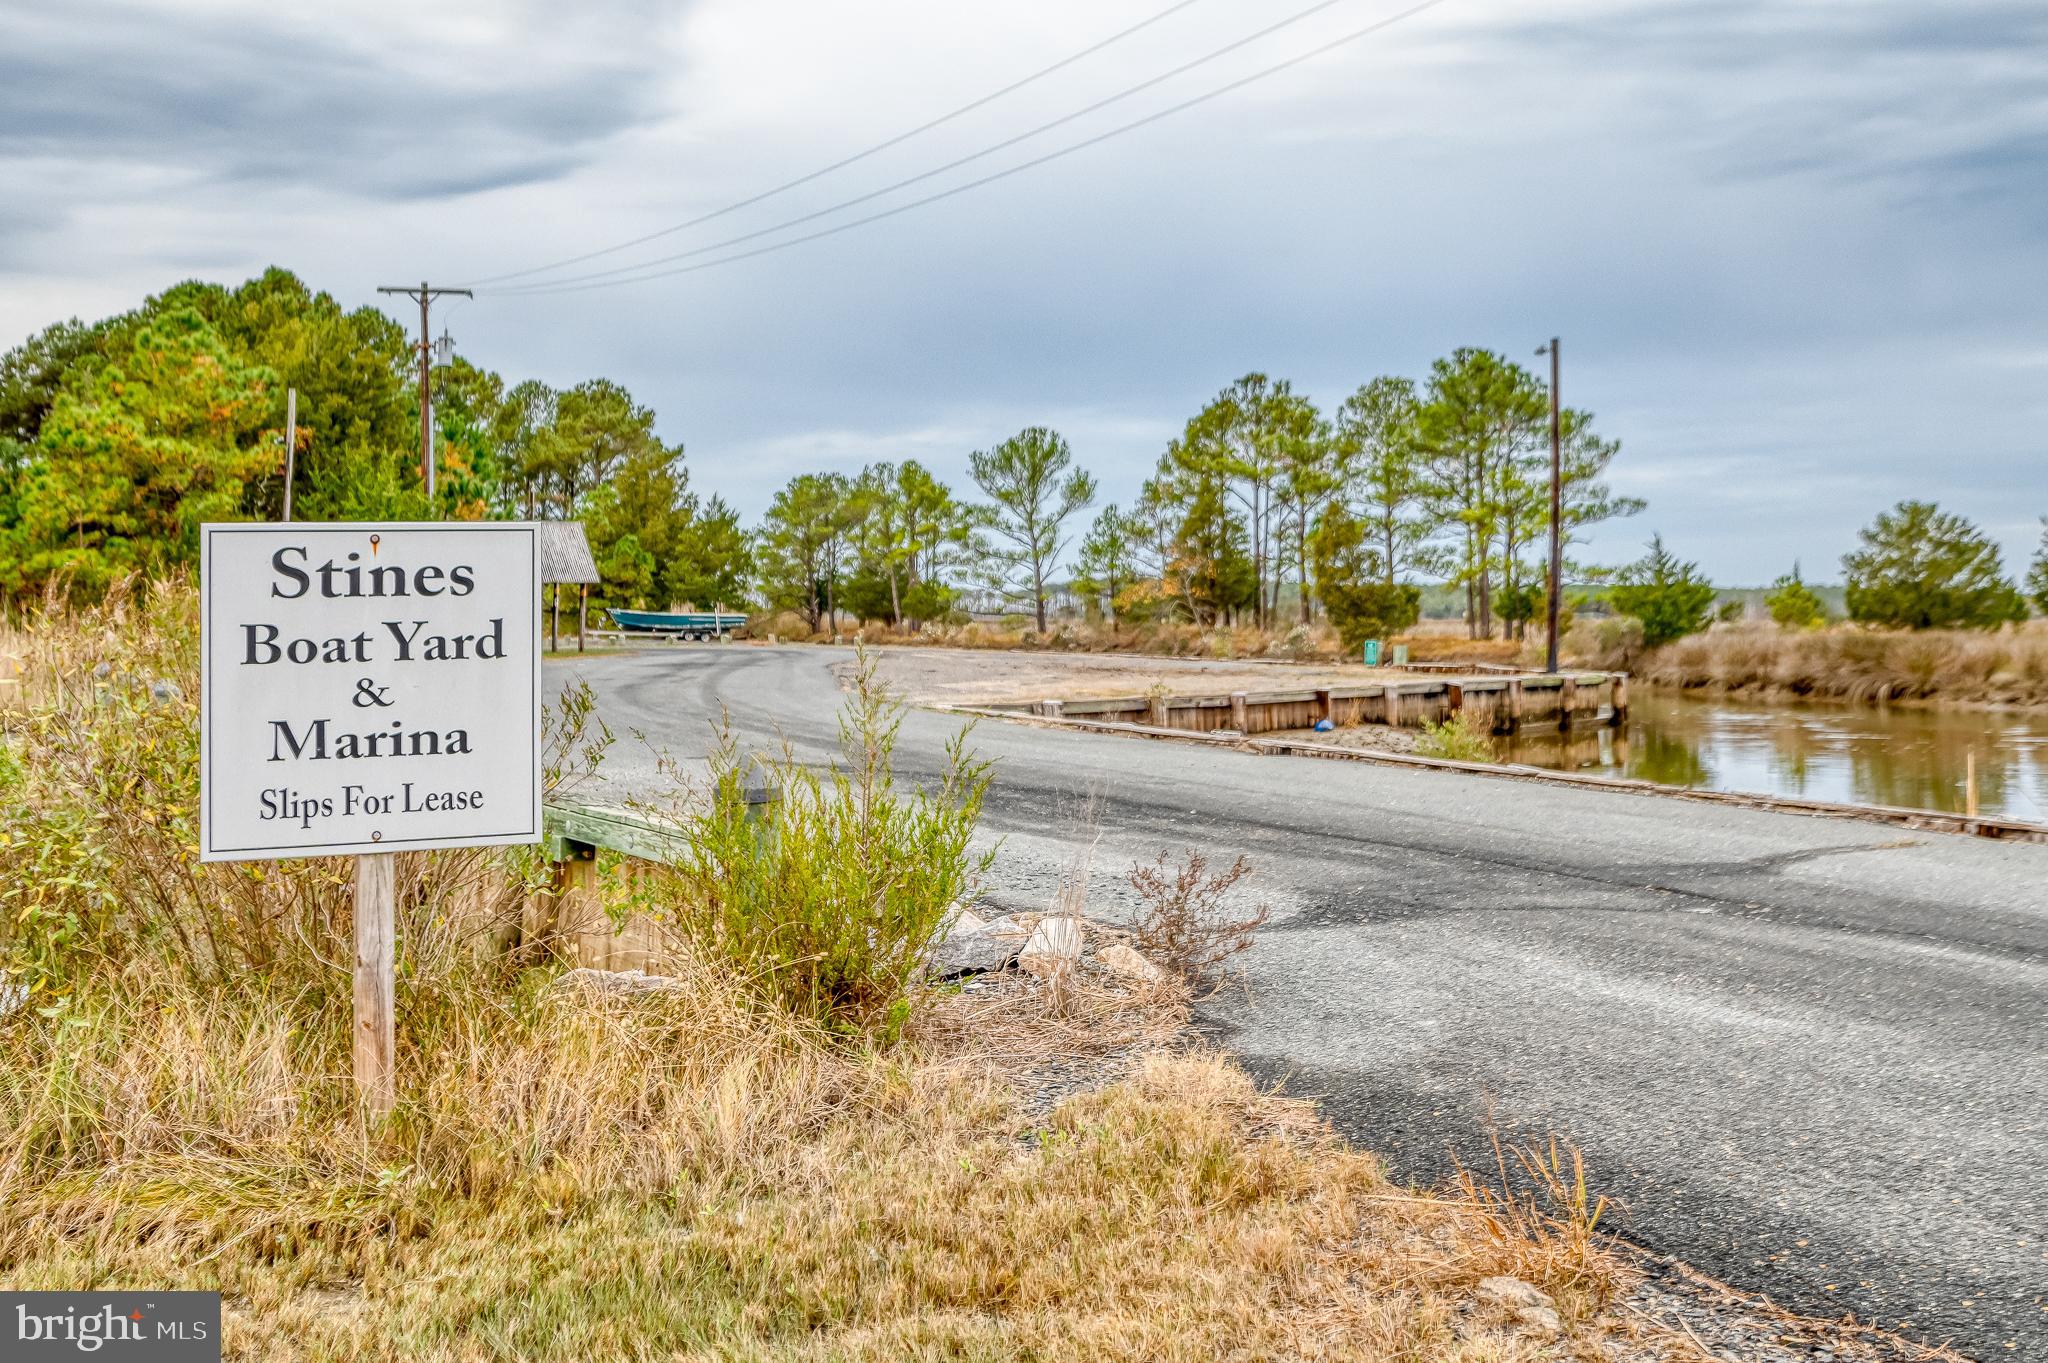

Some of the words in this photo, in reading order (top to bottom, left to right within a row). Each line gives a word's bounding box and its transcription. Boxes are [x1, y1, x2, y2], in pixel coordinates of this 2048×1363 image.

[271, 546, 475, 599] Stines
[239, 623, 373, 665] Boat
[381, 617, 508, 661] Yard
[351, 677, 395, 708] &
[267, 718, 473, 762] Marina
[259, 787, 333, 830] Slips
[341, 785, 394, 816] For
[401, 782, 484, 814] Lease
